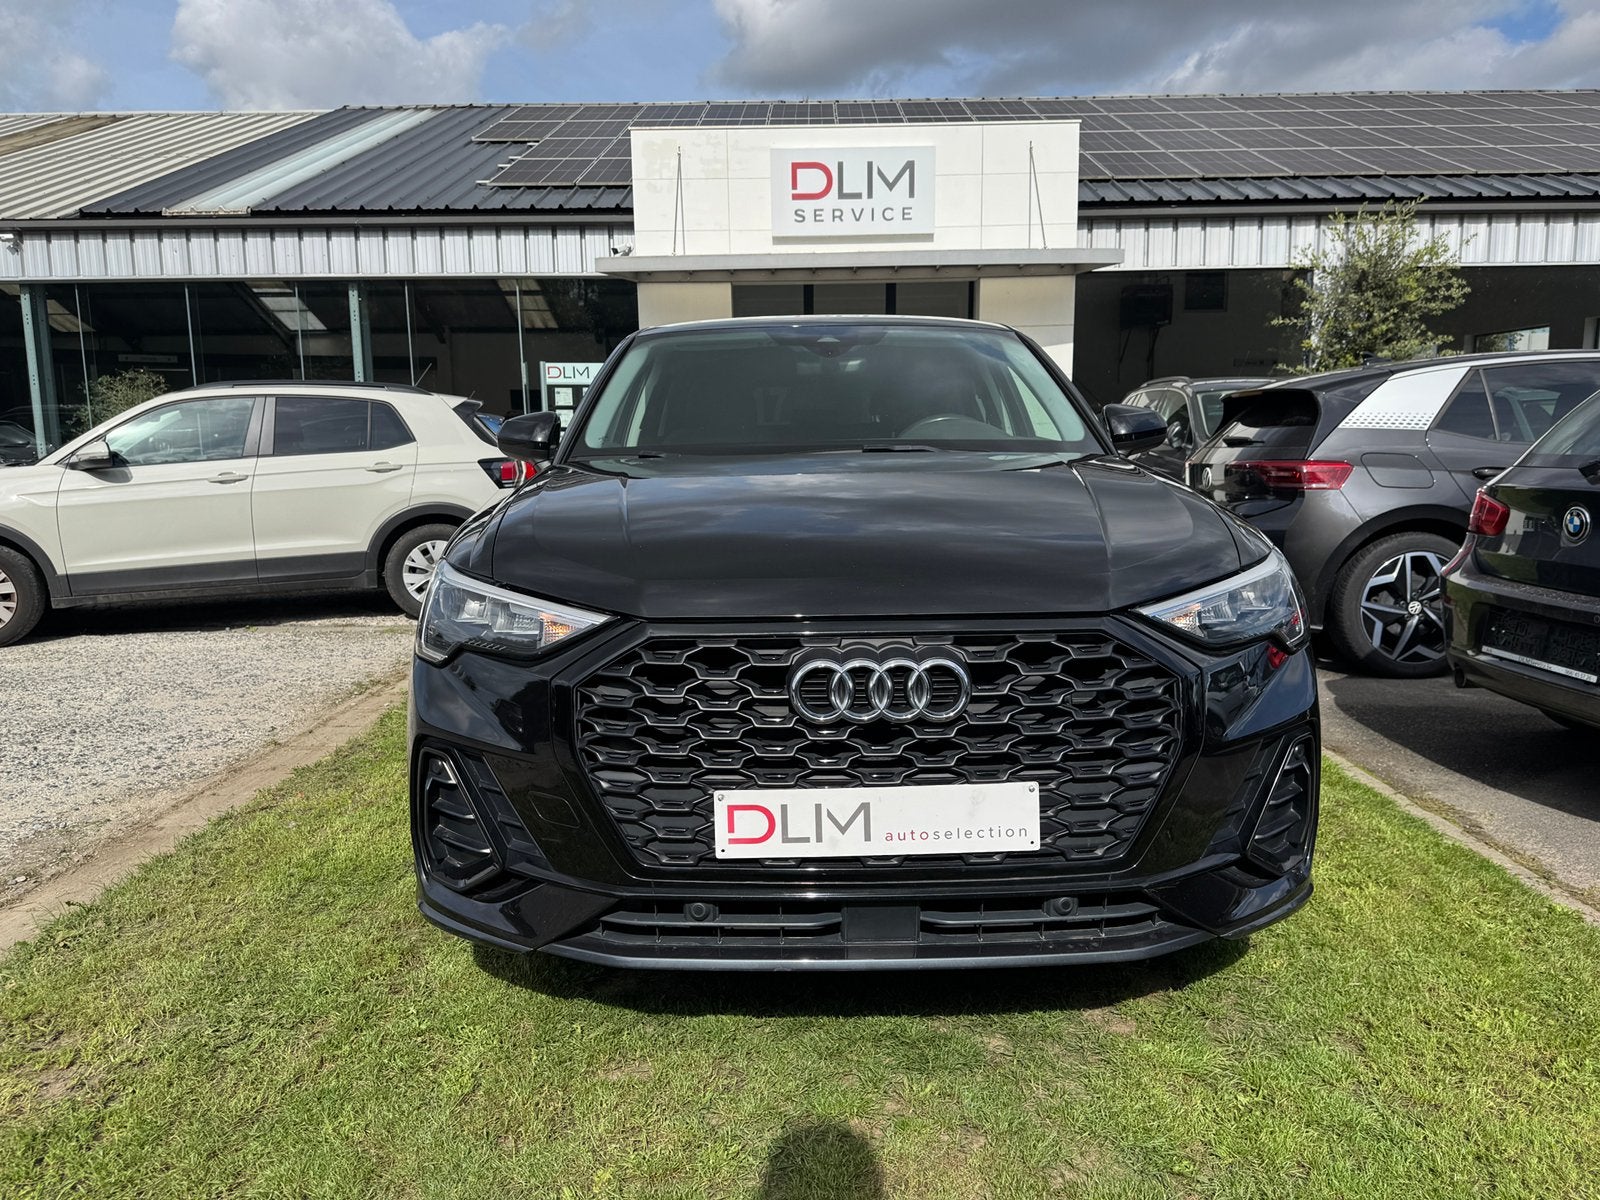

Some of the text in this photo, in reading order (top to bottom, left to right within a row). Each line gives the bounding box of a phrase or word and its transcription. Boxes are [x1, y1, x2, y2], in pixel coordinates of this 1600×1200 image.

[791, 160, 915, 201] DLM
[794, 206, 913, 223] SERVICE
[547, 366, 590, 379] DLM
[727, 801, 1028, 845] DLM autoselection
